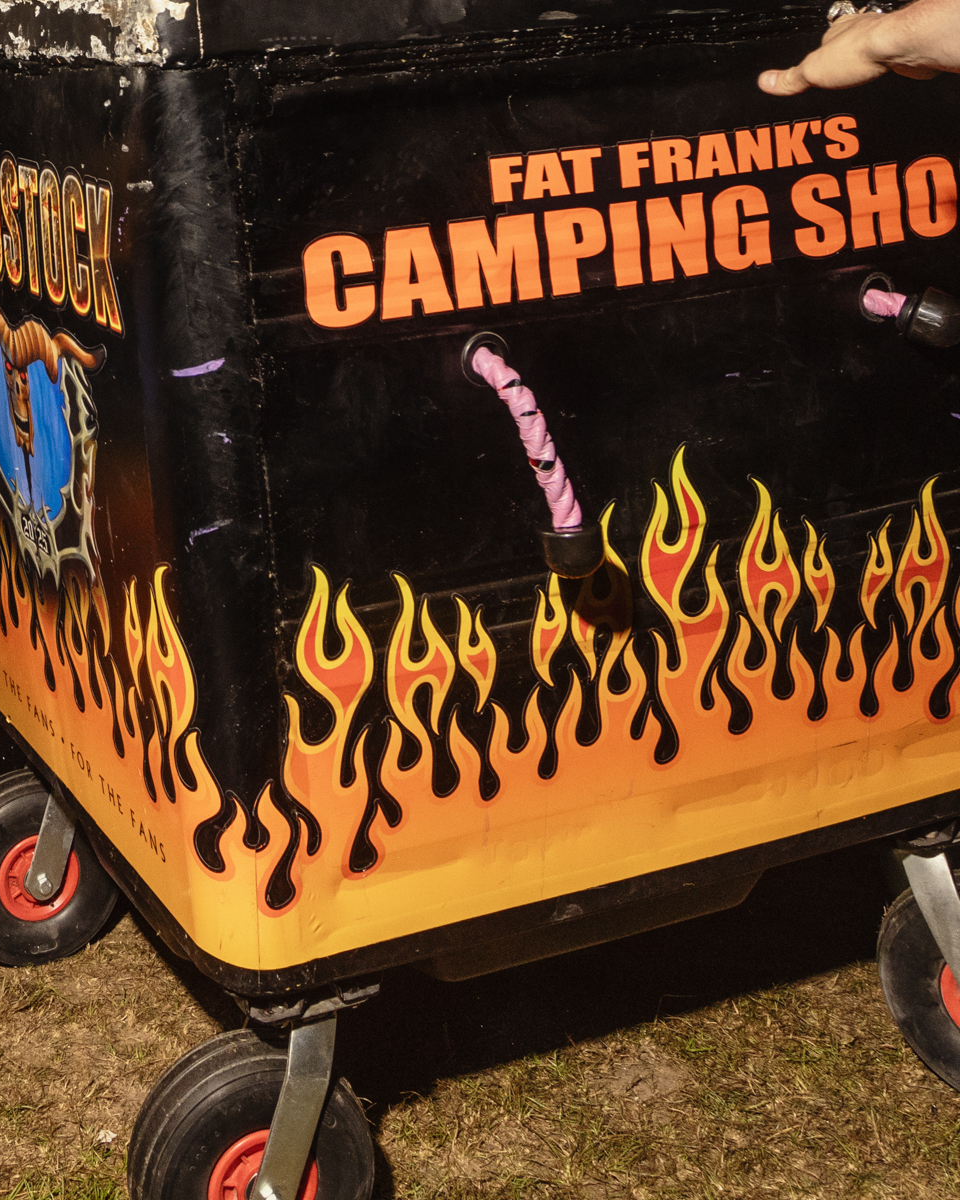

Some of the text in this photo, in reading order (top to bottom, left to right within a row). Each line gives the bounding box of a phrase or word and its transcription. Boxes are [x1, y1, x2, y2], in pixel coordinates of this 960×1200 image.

[489, 114, 860, 205] FAT FRANK'S
[302, 184, 773, 329] CAMPING
[3, 670, 22, 702] THE
[27, 695, 55, 737] FANS
[70, 742, 93, 781] FOR
[99, 774, 124, 815] THE
[130, 808, 166, 863] FANS
